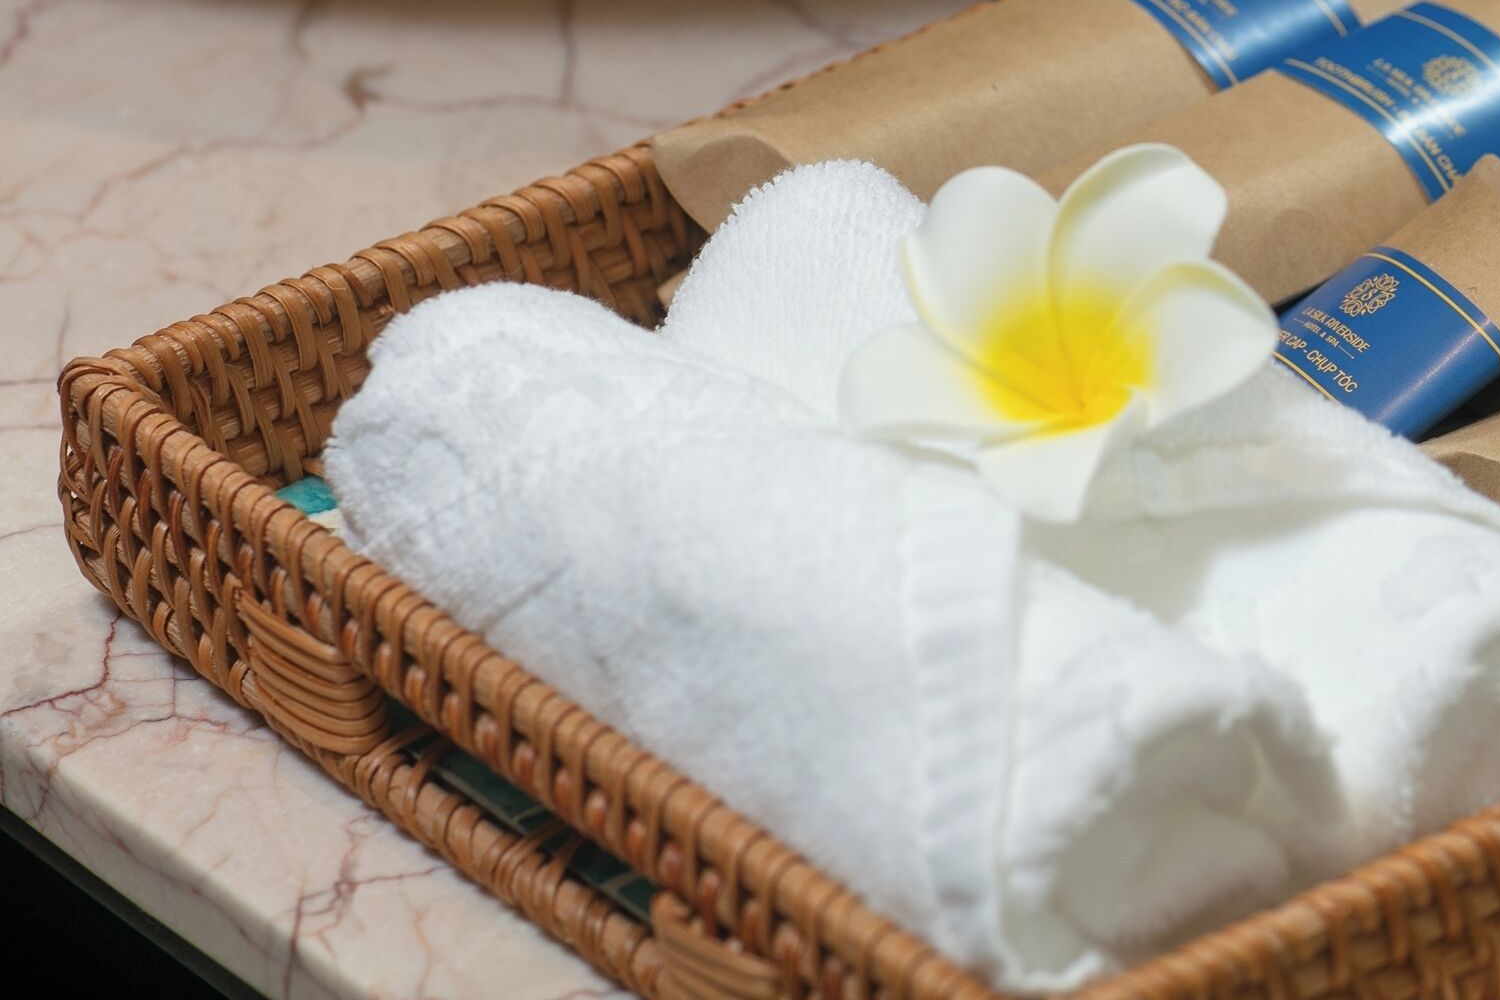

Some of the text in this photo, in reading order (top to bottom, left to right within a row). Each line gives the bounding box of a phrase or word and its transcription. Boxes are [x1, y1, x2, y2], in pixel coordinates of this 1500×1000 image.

[1325, 317, 1370, 353] RIVERSIDE
[1285, 336, 1308, 350] CAP
[1306, 350, 1337, 373] CHỤP
[1333, 370, 1358, 393] TÓC
